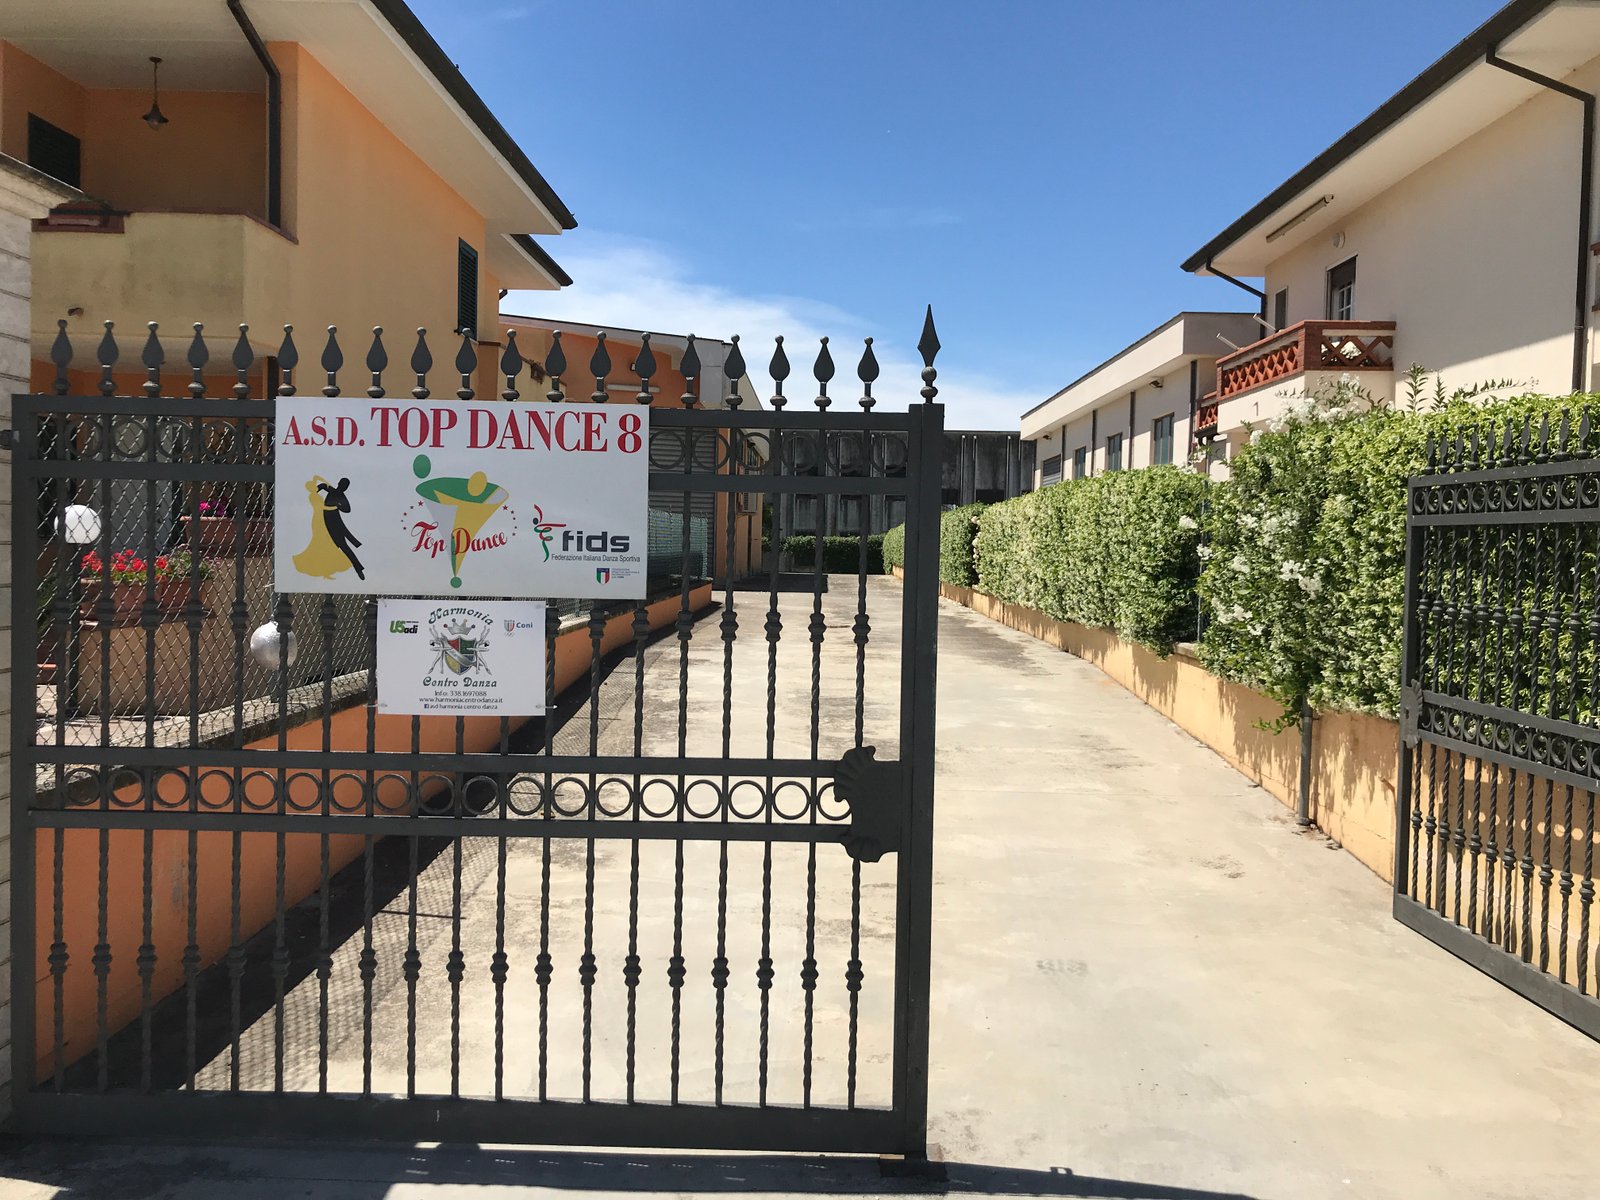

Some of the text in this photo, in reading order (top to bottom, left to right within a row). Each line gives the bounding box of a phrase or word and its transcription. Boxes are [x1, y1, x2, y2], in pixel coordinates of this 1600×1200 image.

[282, 407, 643, 453] A.S.D. TOP DANCE 8
[411, 521, 508, 558] Top Dance
[562, 530, 630, 553] fids
[551, 553, 582, 561] Federazione
[583, 554, 601, 562] Italiana
[620, 555, 640, 563] Sportiva
[428, 607, 494, 625] Harmonia
[516, 621, 533, 629] Coni
[422, 676, 497, 688] Centro Danza
